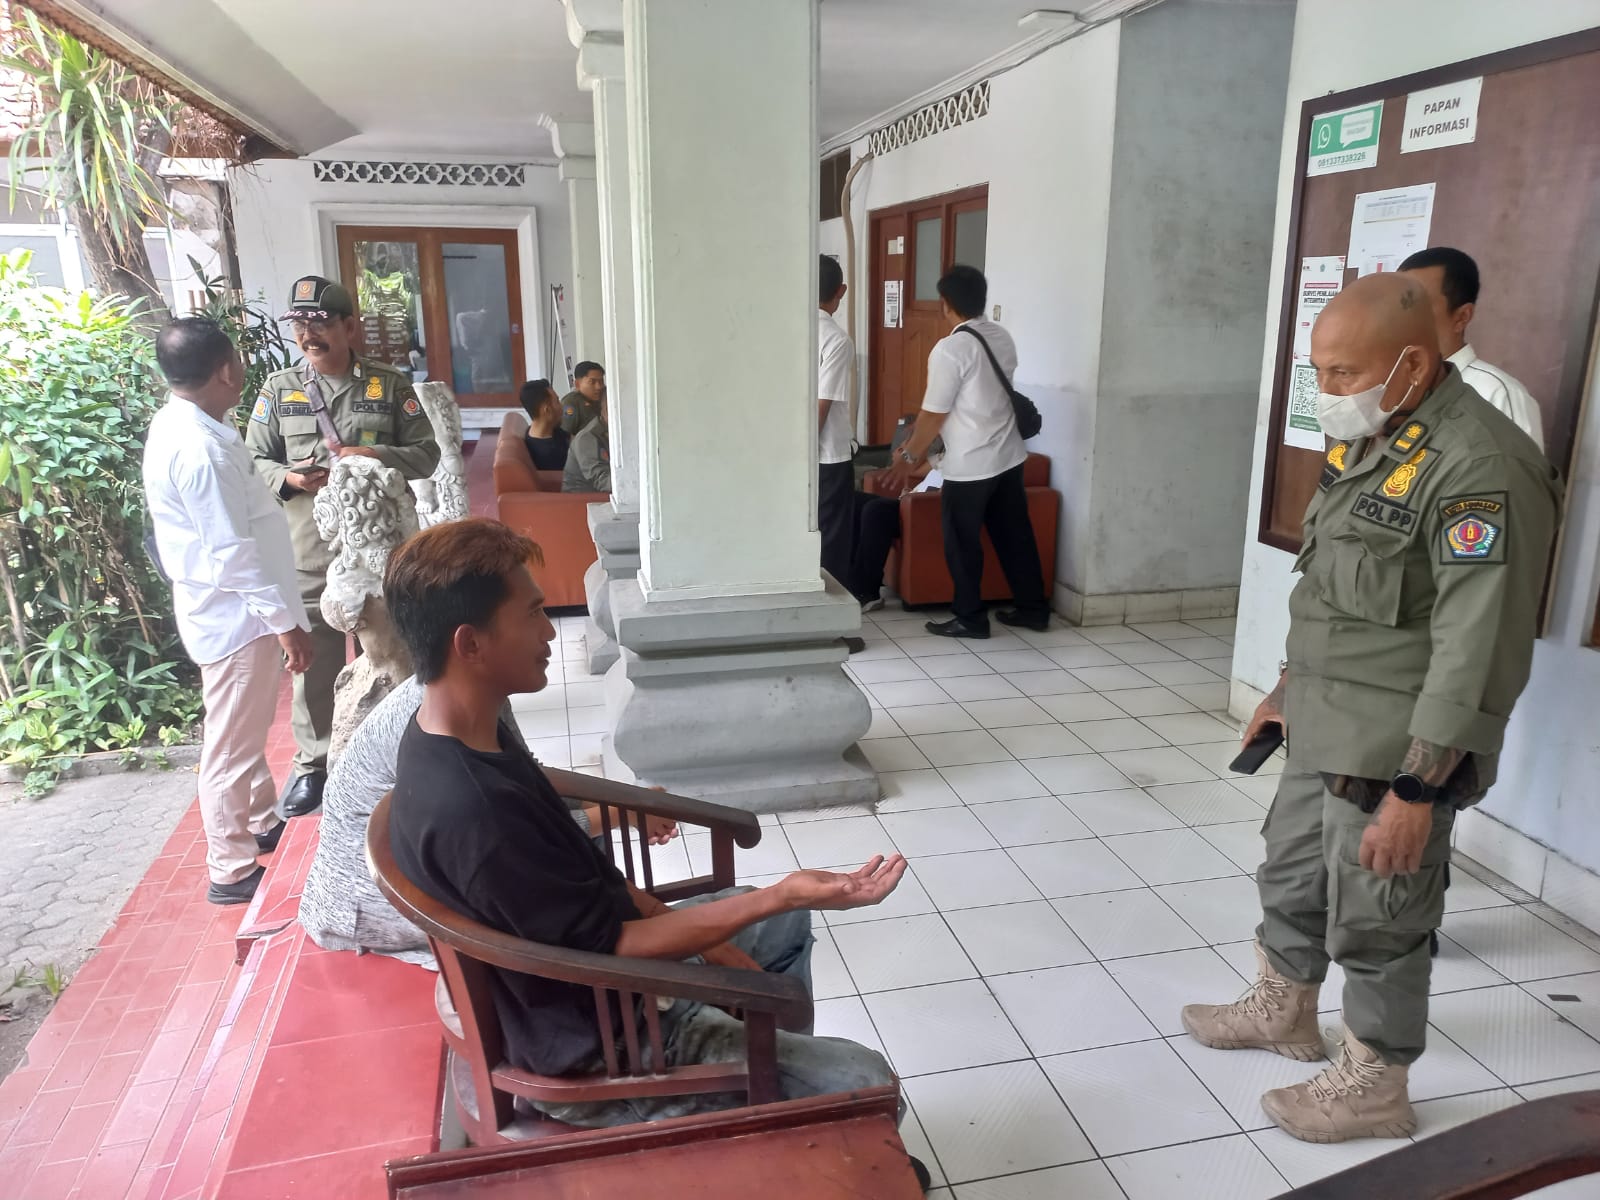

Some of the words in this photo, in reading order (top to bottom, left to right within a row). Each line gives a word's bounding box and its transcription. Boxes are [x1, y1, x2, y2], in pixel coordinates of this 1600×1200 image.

[1423, 97, 1461, 115] PAPAN
[1409, 118, 1470, 139] INFORMASI
[355, 403, 375, 412] POL
[377, 404, 390, 412] PP
[1356, 500, 1384, 522] POL
[1388, 508, 1412, 527] PP
